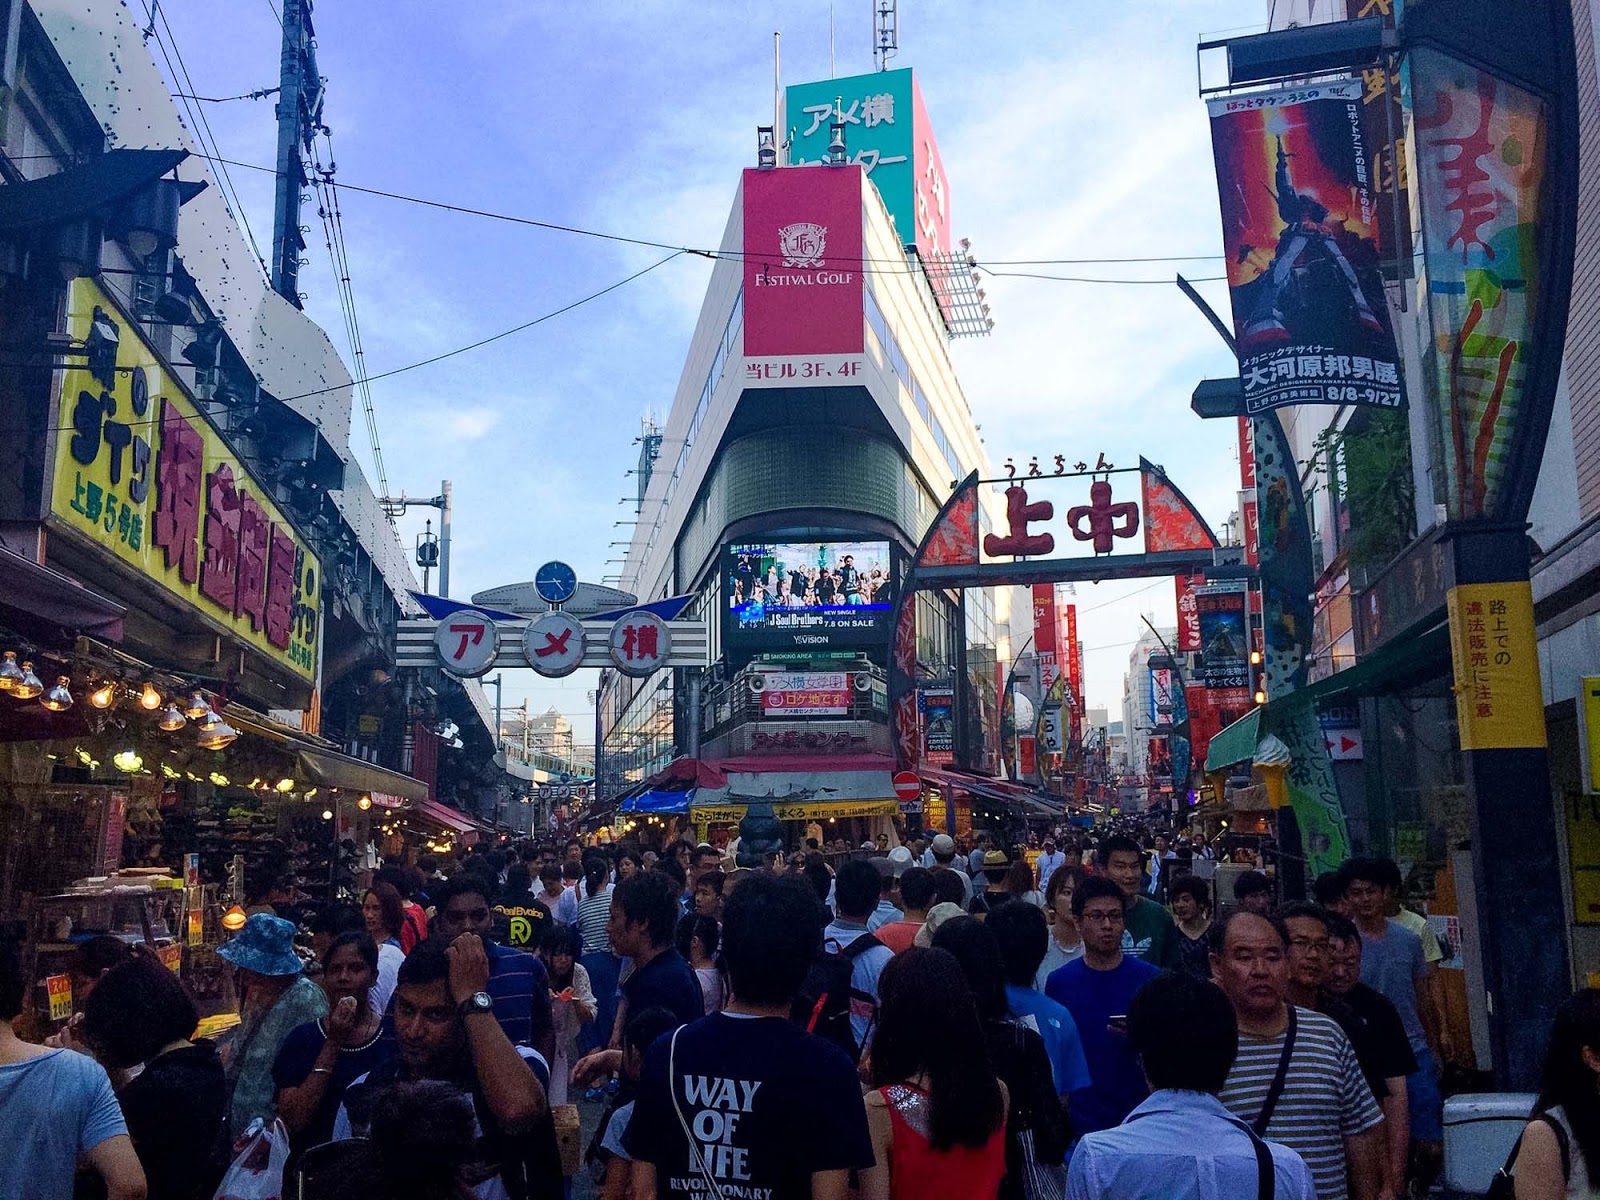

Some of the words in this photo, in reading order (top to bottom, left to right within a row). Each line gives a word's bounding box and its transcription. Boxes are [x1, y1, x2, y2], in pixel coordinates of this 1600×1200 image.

[802, 93, 896, 137] アメ横
[1242, 345, 1334, 368] メカニックデザイナー
[1243, 355, 1399, 391] 大河原邦男展
[1252, 388, 1320, 409] 上野の森美術館
[1004, 452, 1113, 478] うえちゅん
[70, 471, 143, 551] 上野5号店
[984, 481, 1139, 556] 上中
[776, 613, 791, 625] Soul
[1489, 599, 1511, 665] 路上での
[450, 624, 658, 660] アメ横
[1466, 601, 1493, 718] 違法販売に注意
[771, 675, 843, 690] アメ横女学園
[787, 693, 843, 705] ロケ地です
[694, 810, 742, 822] たらばがに
[778, 807, 807, 819] まぐろ
[683, 1074, 762, 1113] WAY
[693, 1109, 740, 1146] OF
[688, 1143, 752, 1181] LIFE
[670, 1177, 773, 1200] REVOLIONARY
